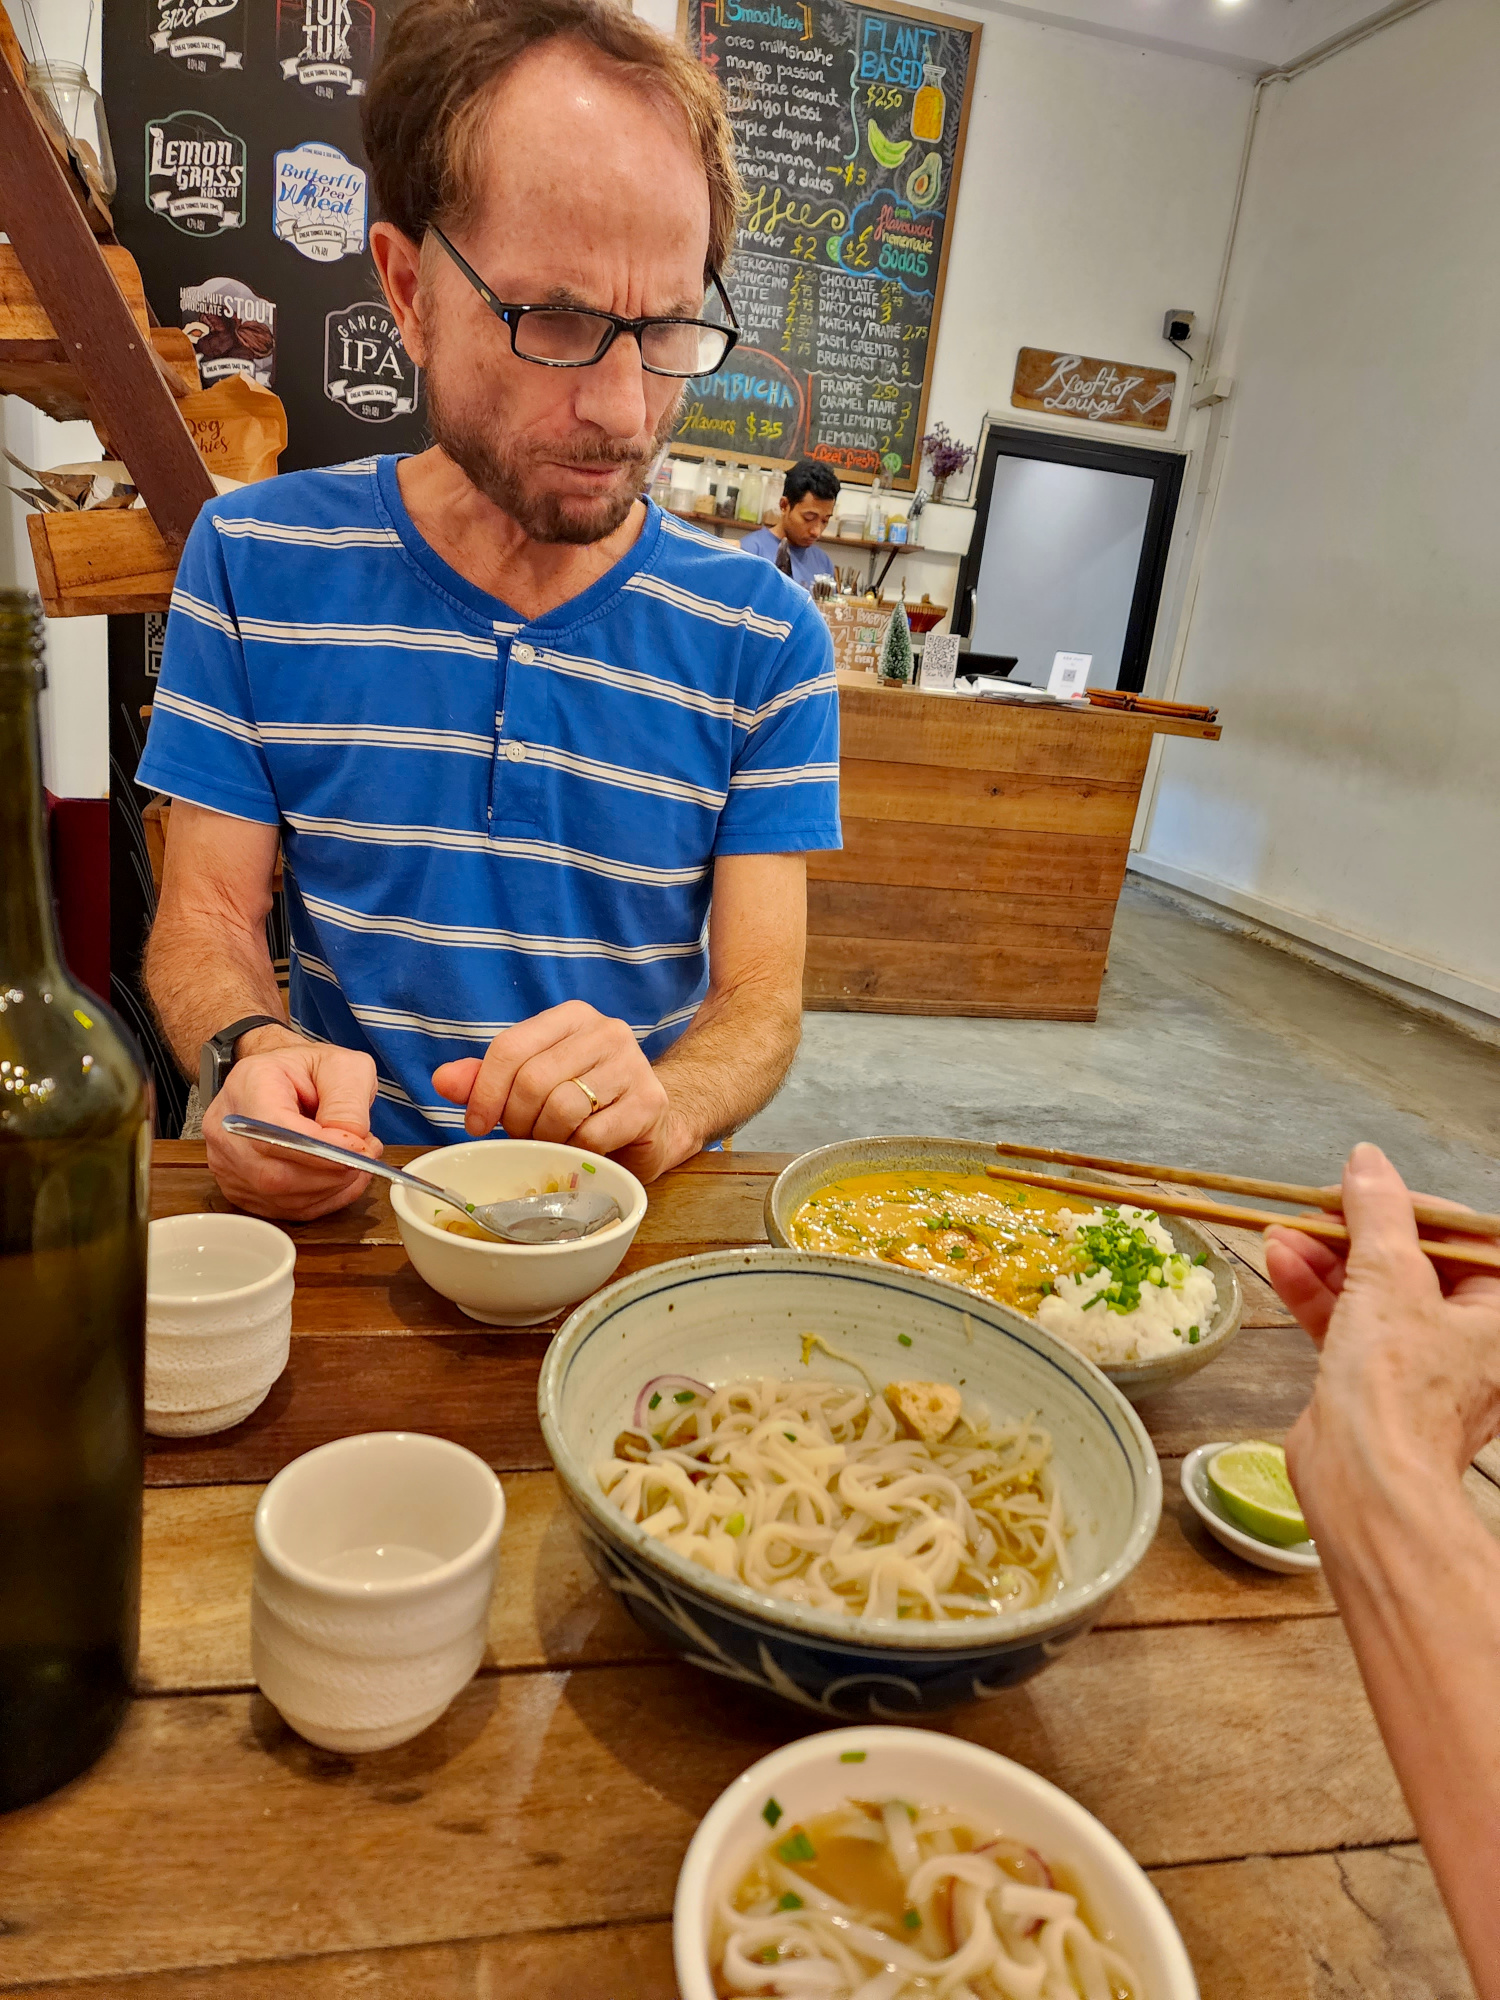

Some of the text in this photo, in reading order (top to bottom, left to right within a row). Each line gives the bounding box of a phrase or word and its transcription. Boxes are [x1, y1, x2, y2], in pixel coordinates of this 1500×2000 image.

[158, 6, 196, 31] SIDE
[725, 35, 834, 67] oreo milkshake
[864, 18, 937, 64] PLANT
[726, 55, 825, 83] mango passion
[860, 50, 923, 89] BASED
[792, 85, 840, 108] coconut
[772, 121, 813, 151] dragon
[814, 130, 841, 154] fruit
[176, 166, 244, 191] GRASS
[281, 163, 363, 196] Butterfly
[787, 169, 796, 185] &
[799, 171, 834, 195] dates
[279, 181, 353, 215] Wheat
[320, 186, 345, 200] Pea
[790, 234, 817, 261] $2
[842, 240, 871, 267] $2
[882, 229, 933, 254] homemade
[819, 272, 876, 292] CHOCOLATE
[180, 287, 223, 305] HAZELNUT
[180, 300, 222, 316] CHOCOLATE
[819, 286, 845, 302] CHAI
[849, 292, 879, 306] LATTE
[223, 295, 276, 325] STOUT
[748, 314, 780, 330] BLACK
[749, 301, 783, 318] WHITE
[819, 300, 852, 318] DIRTY
[853, 305, 877, 319] CHAI
[902, 325, 928, 341] 2.75
[339, 337, 404, 380] IPA
[817, 350, 911, 376] BREAKFAST TEA 2
[902, 348, 910, 358] 2
[1035, 354, 1144, 406] Rooftop
[677, 402, 736, 436] flavours
[820, 395, 864, 411] CARAMEL
[899, 401, 912, 421] 3
[1043, 394, 1125, 420] Lounge
[819, 412, 905, 438] ICE LEMON TEA 2
[879, 436, 890, 452] 2
